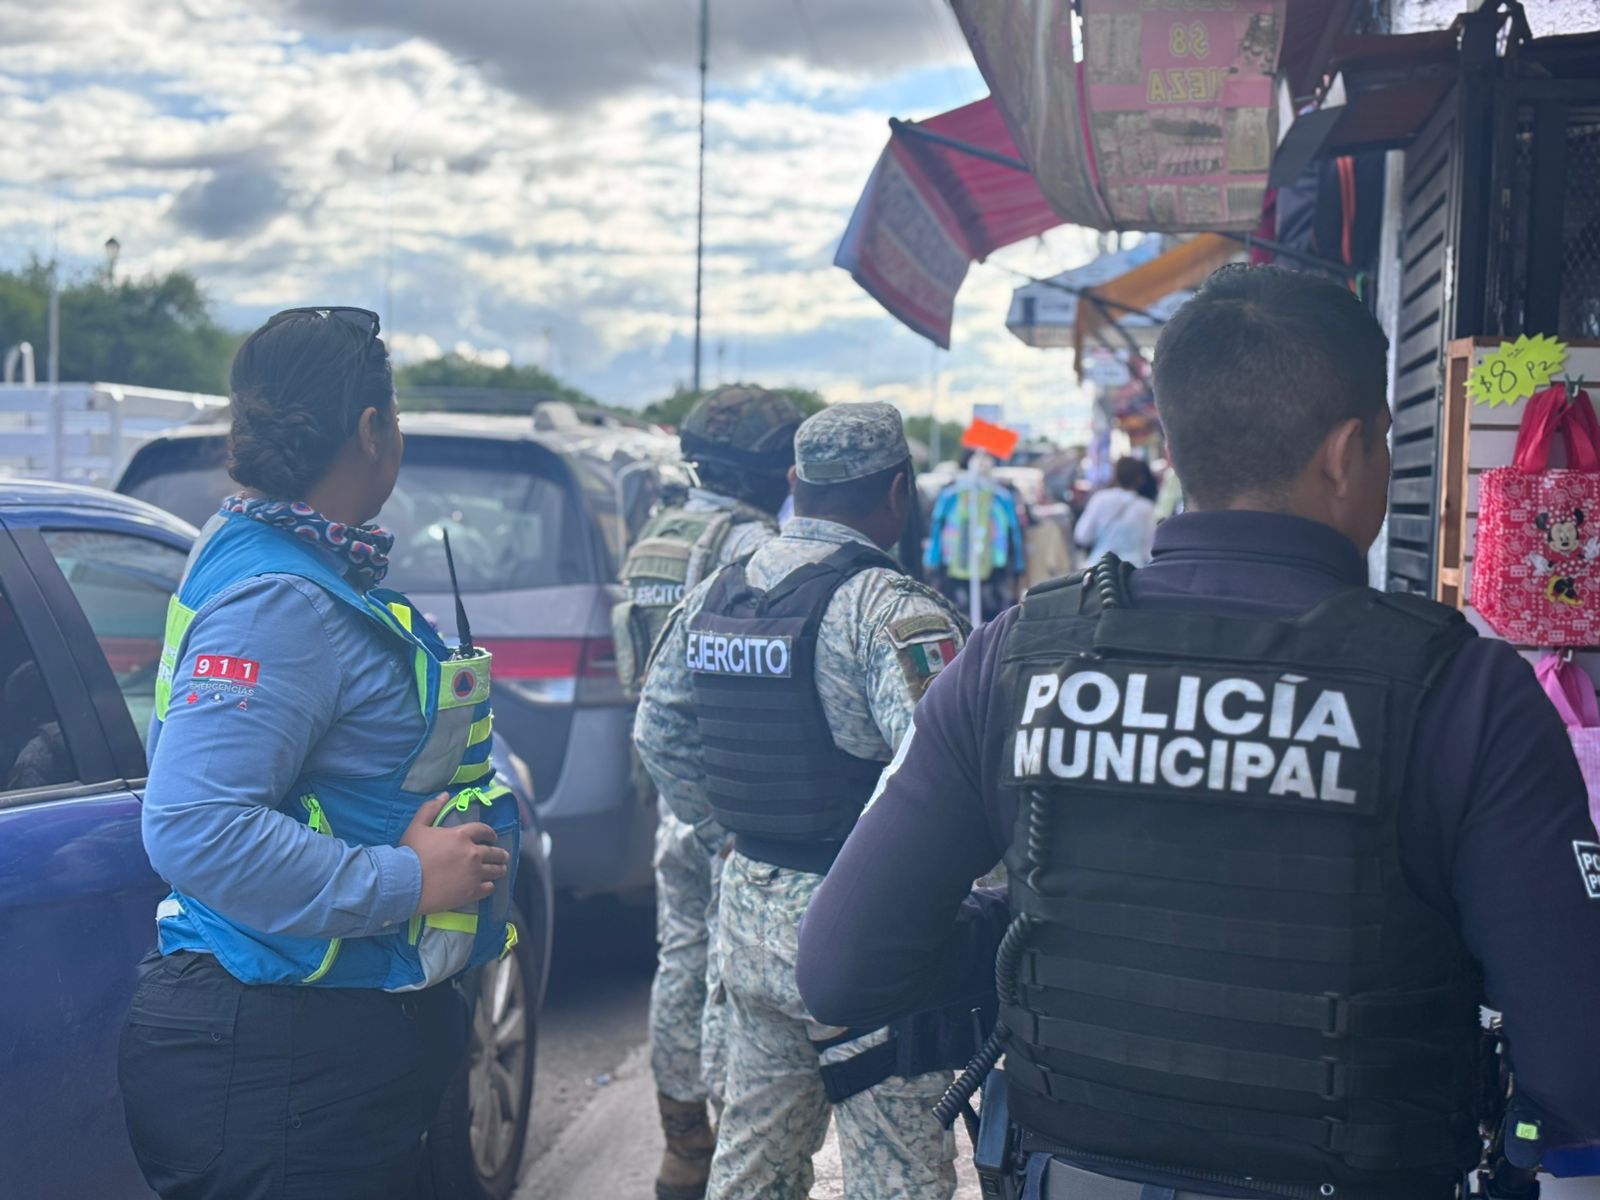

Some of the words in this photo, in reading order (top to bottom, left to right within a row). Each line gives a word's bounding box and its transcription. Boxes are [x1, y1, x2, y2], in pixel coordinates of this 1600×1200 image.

[189, 682, 255, 697] EMERGENCIAS
[1020, 671, 1361, 749] POLICÍA
[1014, 728, 1357, 804] MUNICIPAL
